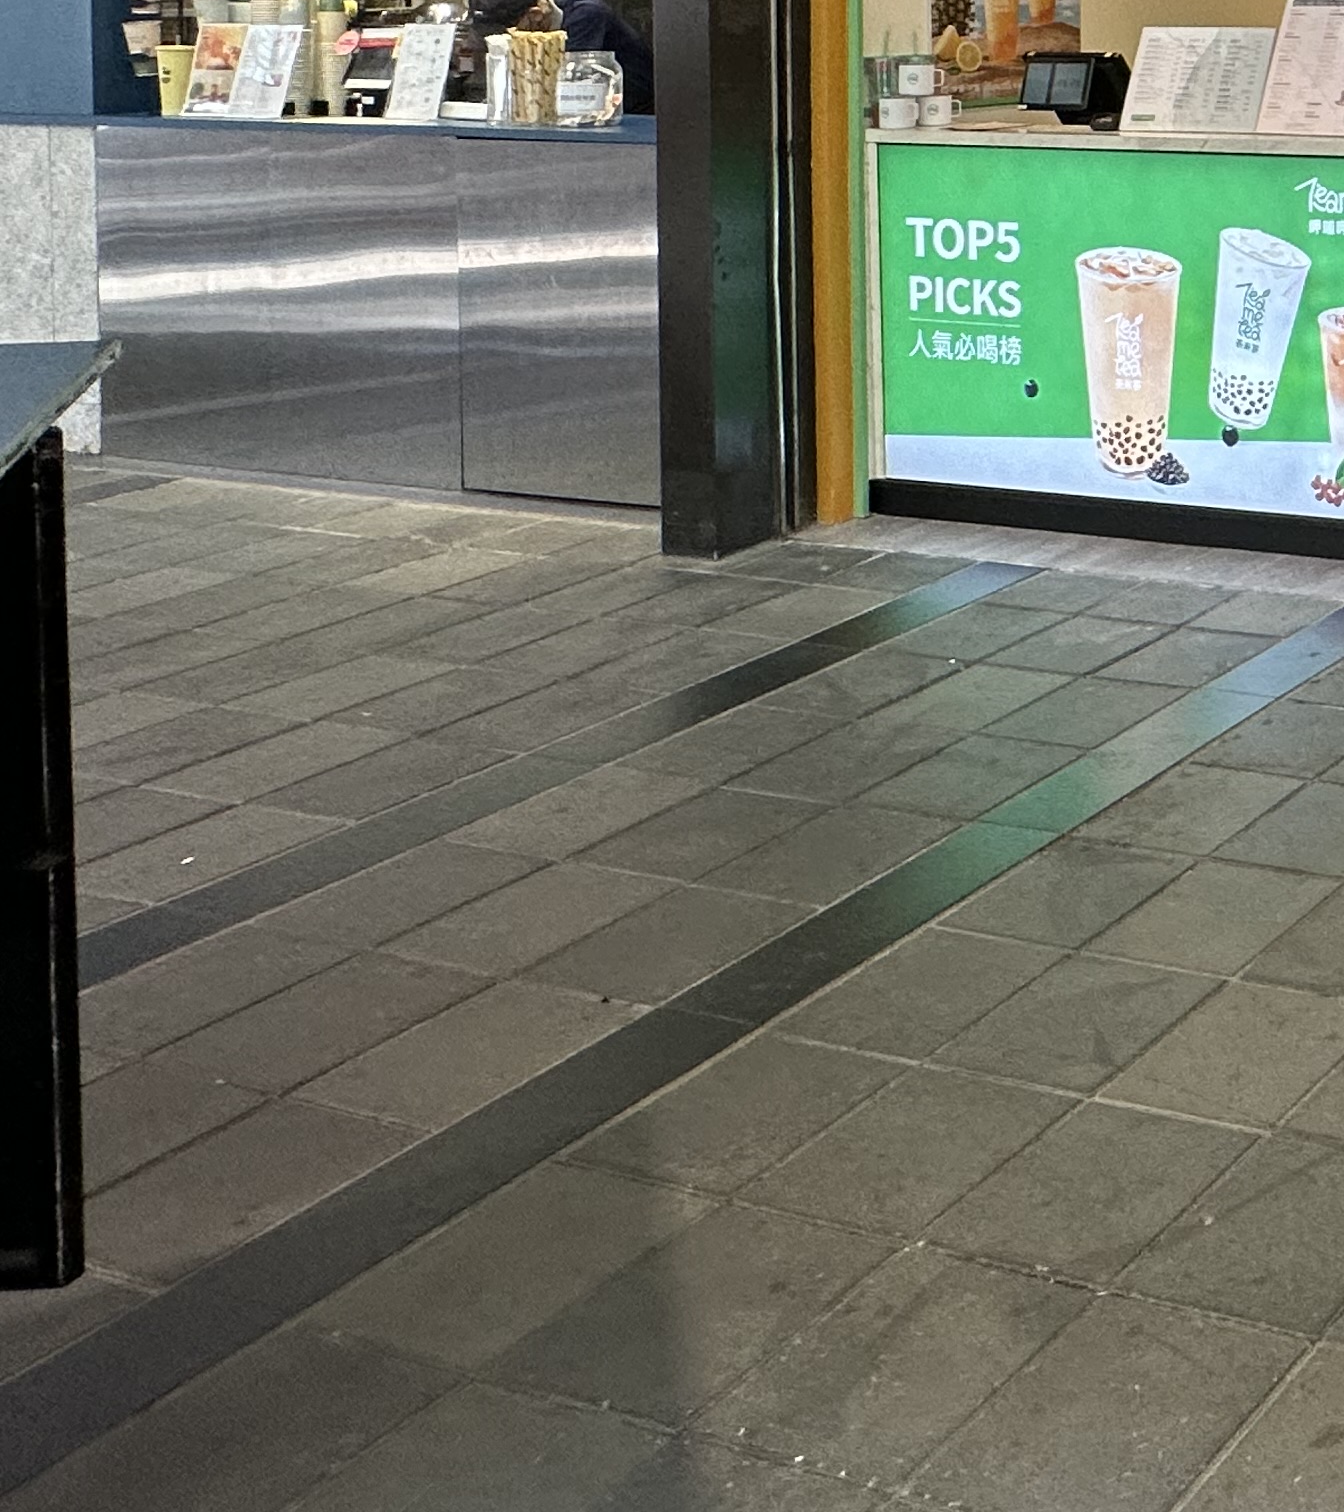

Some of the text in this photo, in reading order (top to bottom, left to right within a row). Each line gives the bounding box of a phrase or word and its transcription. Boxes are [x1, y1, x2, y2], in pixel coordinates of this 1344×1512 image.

[905, 216, 1021, 263] TOP5
[908, 275, 1022, 318] PICKS
[908, 328, 1022, 366] 人氣必喝榜
